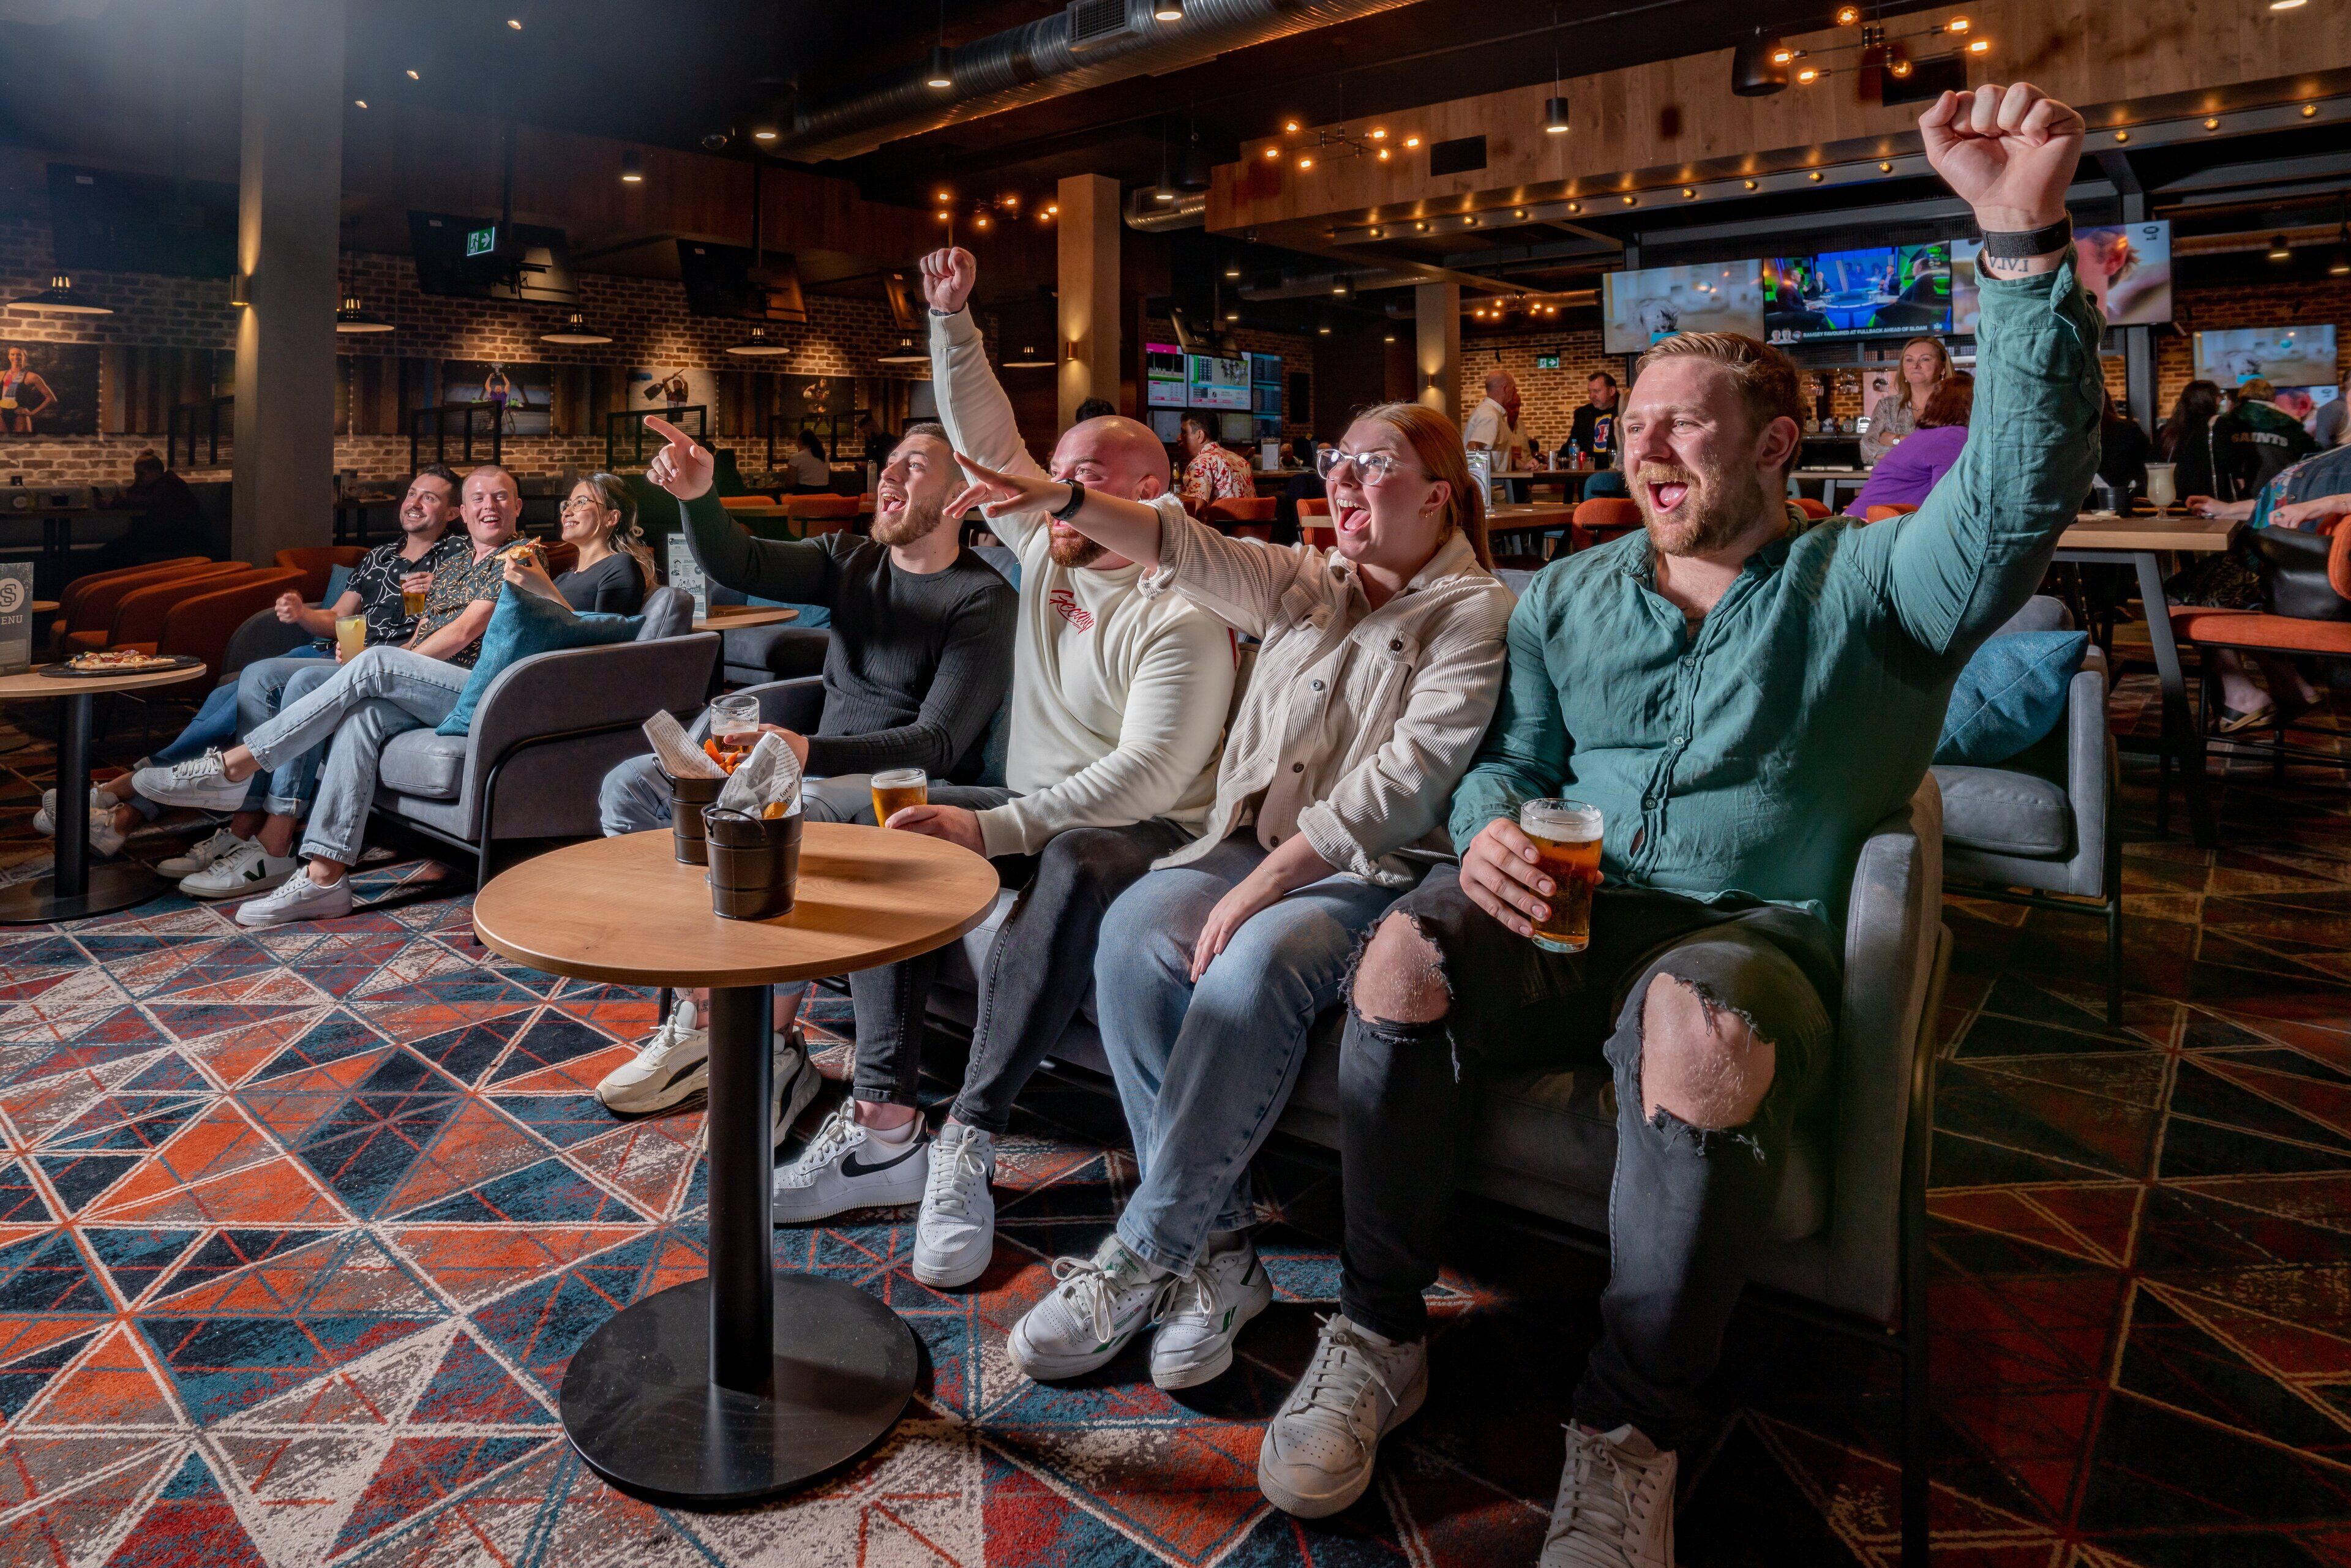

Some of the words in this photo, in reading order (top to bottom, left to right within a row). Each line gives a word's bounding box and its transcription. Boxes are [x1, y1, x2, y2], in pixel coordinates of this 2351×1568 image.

[2231, 432, 2289, 447] SAINTS
[0, 615, 24, 625] ENU
[779, 787, 789, 798] for
[784, 793, 792, 804] rty
[1117, 1248, 1140, 1274] Reebok
[1113, 1311, 1134, 1330] Reebok
